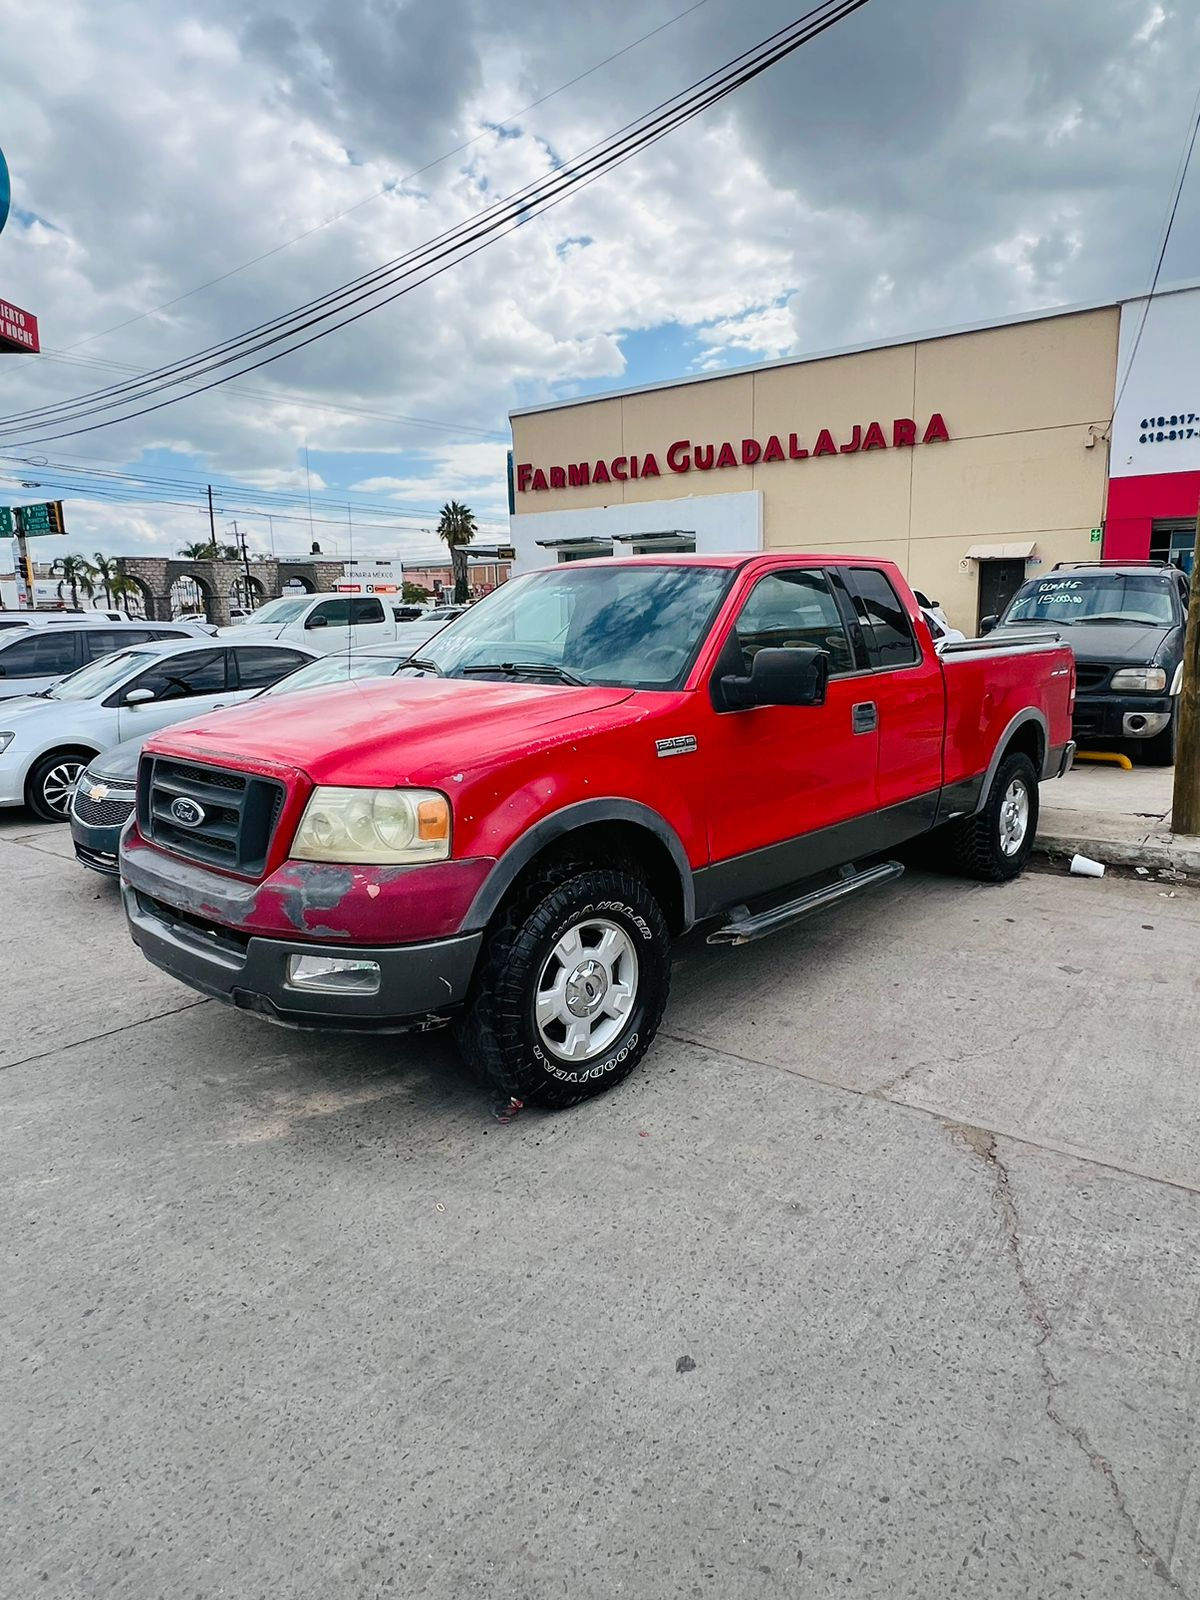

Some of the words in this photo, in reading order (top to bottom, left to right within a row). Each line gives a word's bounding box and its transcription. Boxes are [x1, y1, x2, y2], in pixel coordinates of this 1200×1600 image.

[6, 321, 33, 346] NOCHE
[1139, 428, 1200, 444] 618-817-
[517, 453, 660, 492] FARMACIA
[667, 413, 949, 473] GUADALAJARA
[551, 901, 652, 940] WRANGLER
